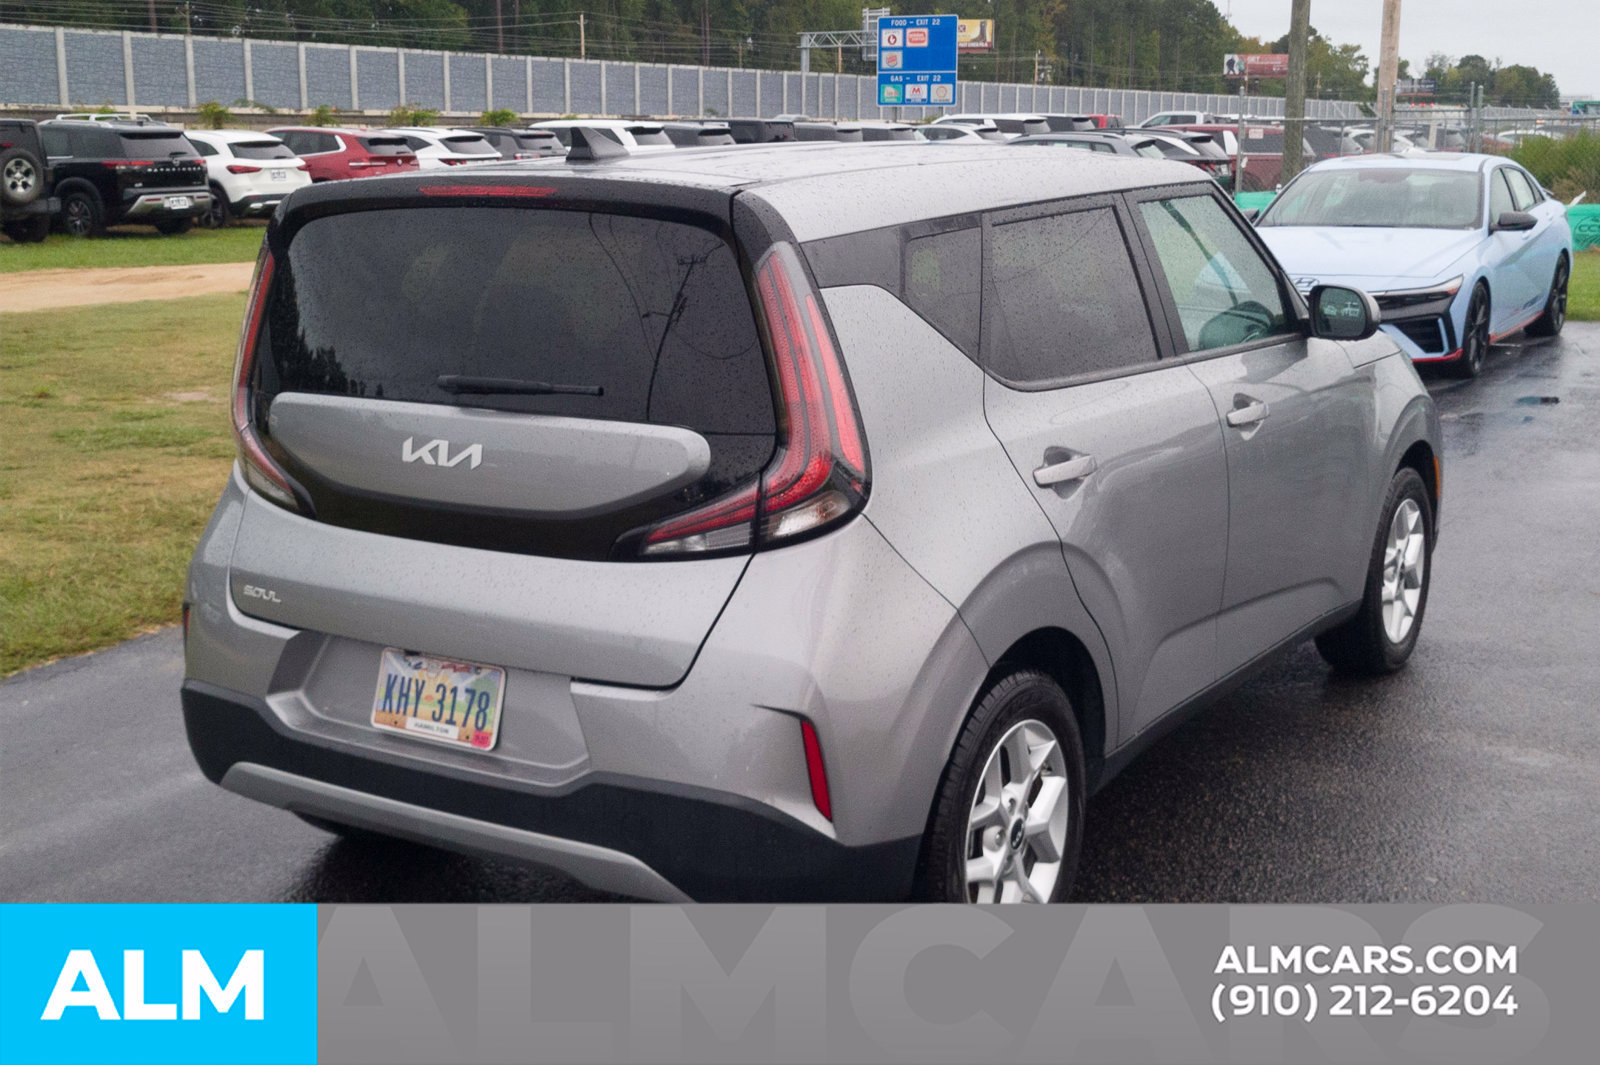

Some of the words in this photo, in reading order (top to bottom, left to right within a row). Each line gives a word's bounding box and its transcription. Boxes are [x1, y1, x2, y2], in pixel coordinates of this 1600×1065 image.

[402, 436, 483, 470] KIA
[243, 584, 282, 603] SOUL
[382, 673, 426, 718] KHY
[431, 683, 490, 732] 3178
